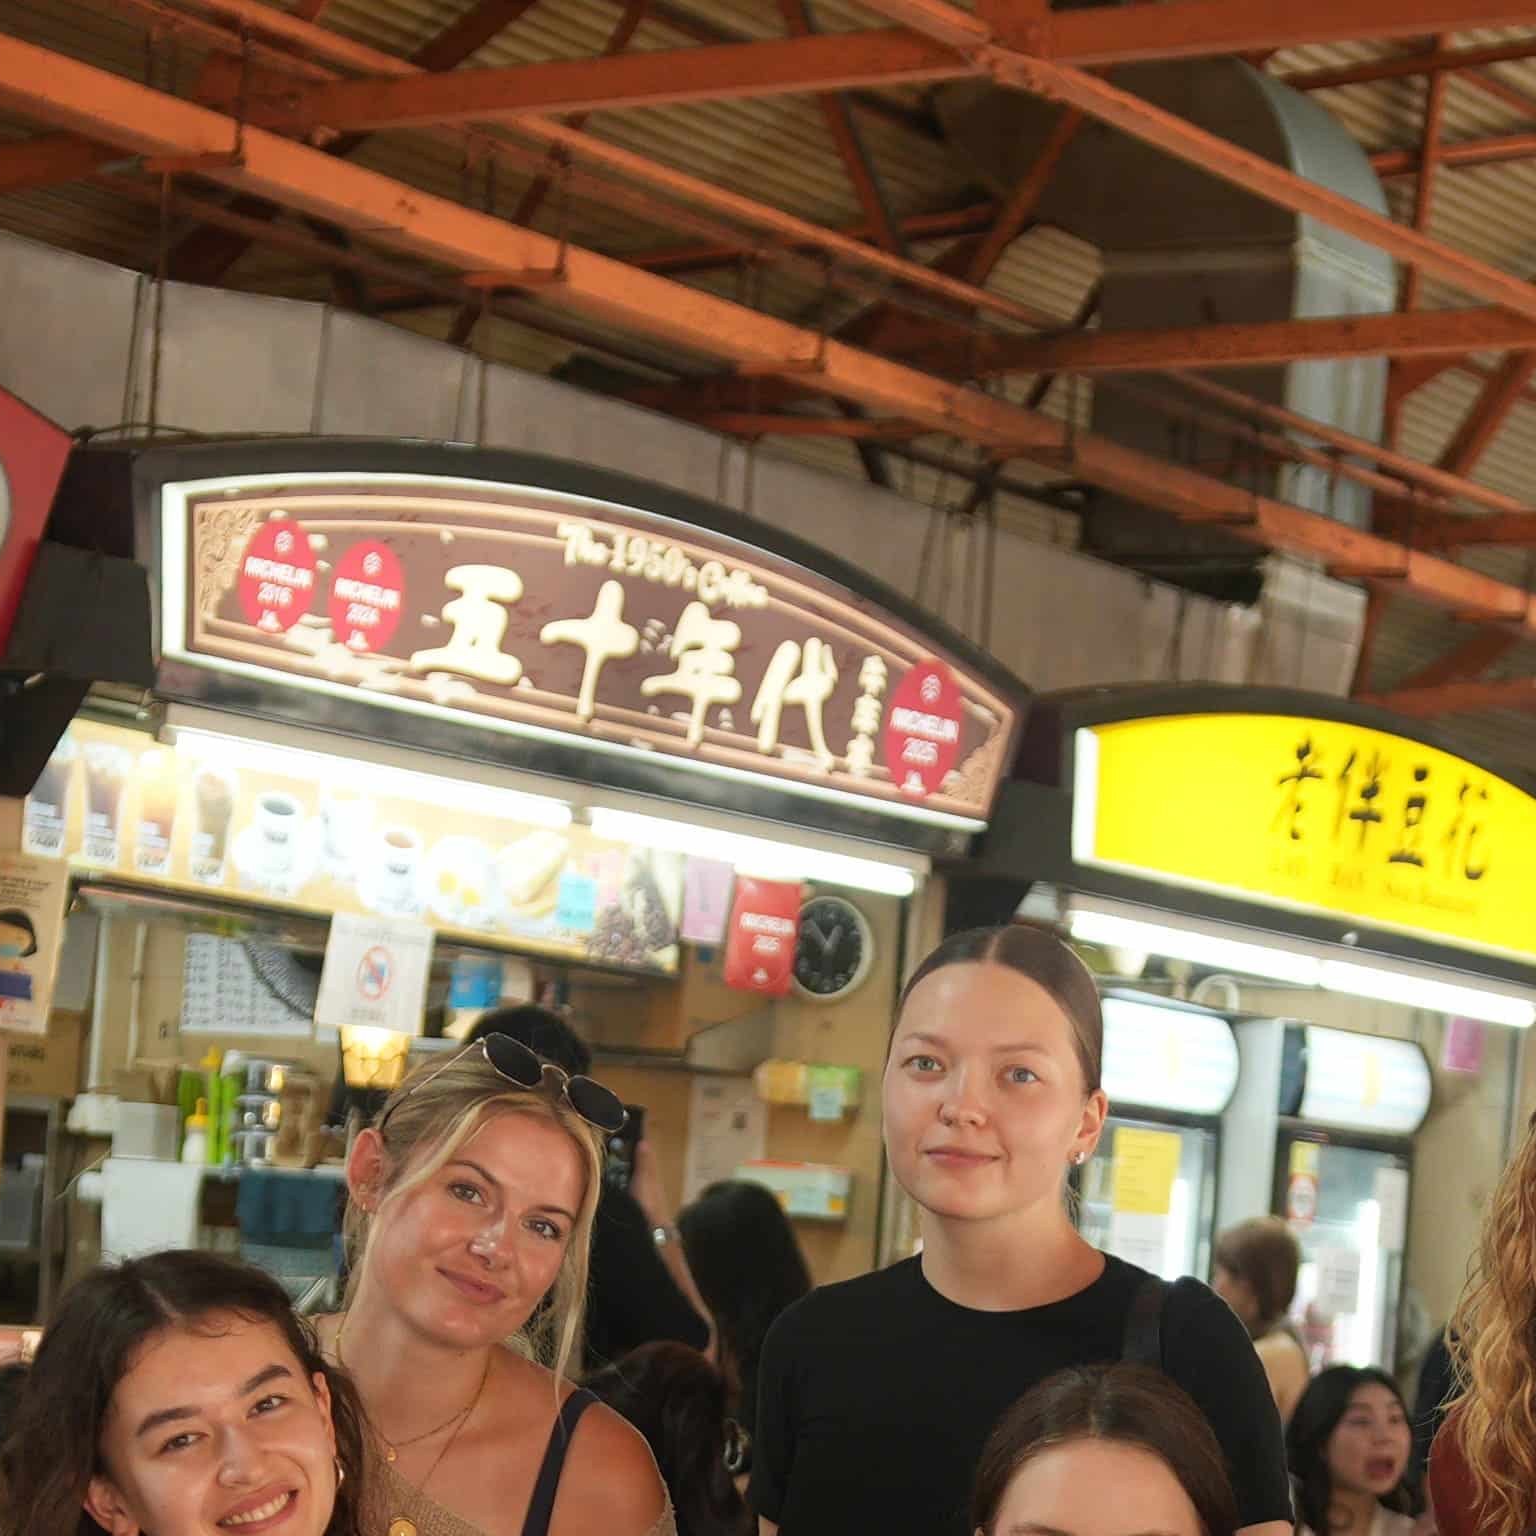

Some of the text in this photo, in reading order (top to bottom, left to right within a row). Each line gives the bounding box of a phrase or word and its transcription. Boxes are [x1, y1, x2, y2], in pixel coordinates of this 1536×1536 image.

[244, 556, 314, 588] MICHELIN
[334, 577, 401, 609] MICHELIN
[409, 563, 839, 774] 五十年代
[890, 706, 961, 744] MICHELIN
